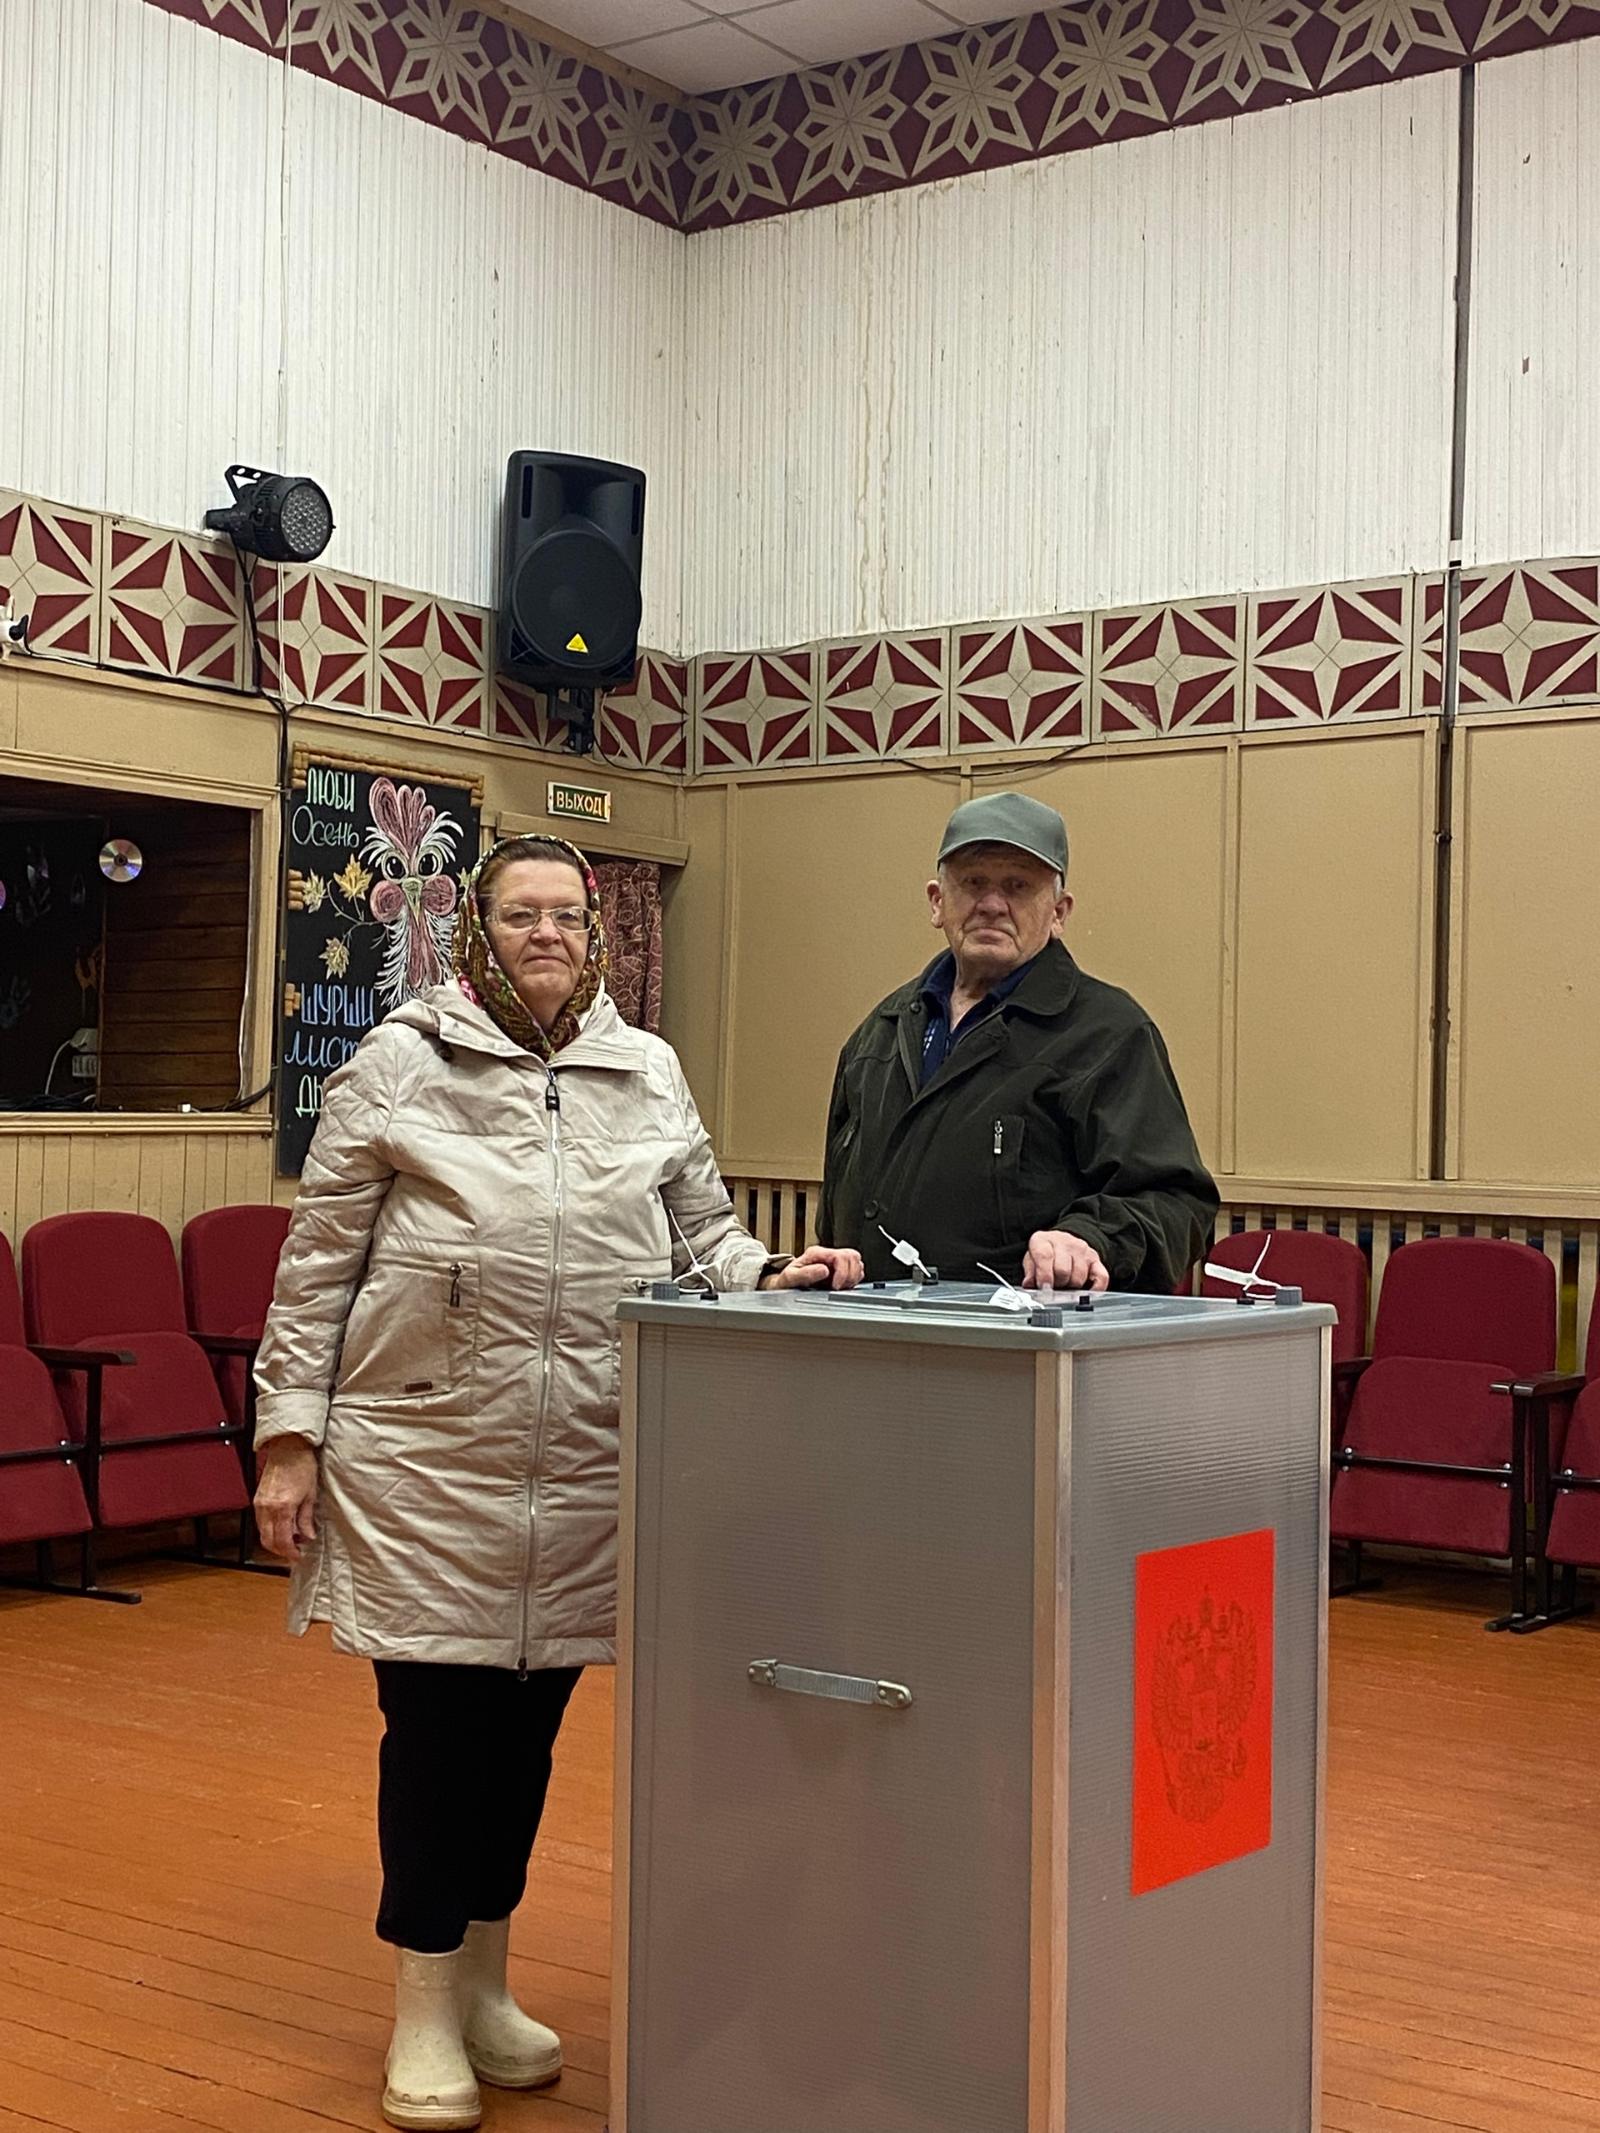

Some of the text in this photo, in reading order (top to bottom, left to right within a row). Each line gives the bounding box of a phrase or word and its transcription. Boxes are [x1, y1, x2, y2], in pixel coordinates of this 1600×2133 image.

[306, 767, 355, 812] ЛЮБИ
[556, 791, 602, 817] ВЫХОД
[292, 805, 360, 848] Осень
[301, 982, 375, 1027] ШУРШИ
